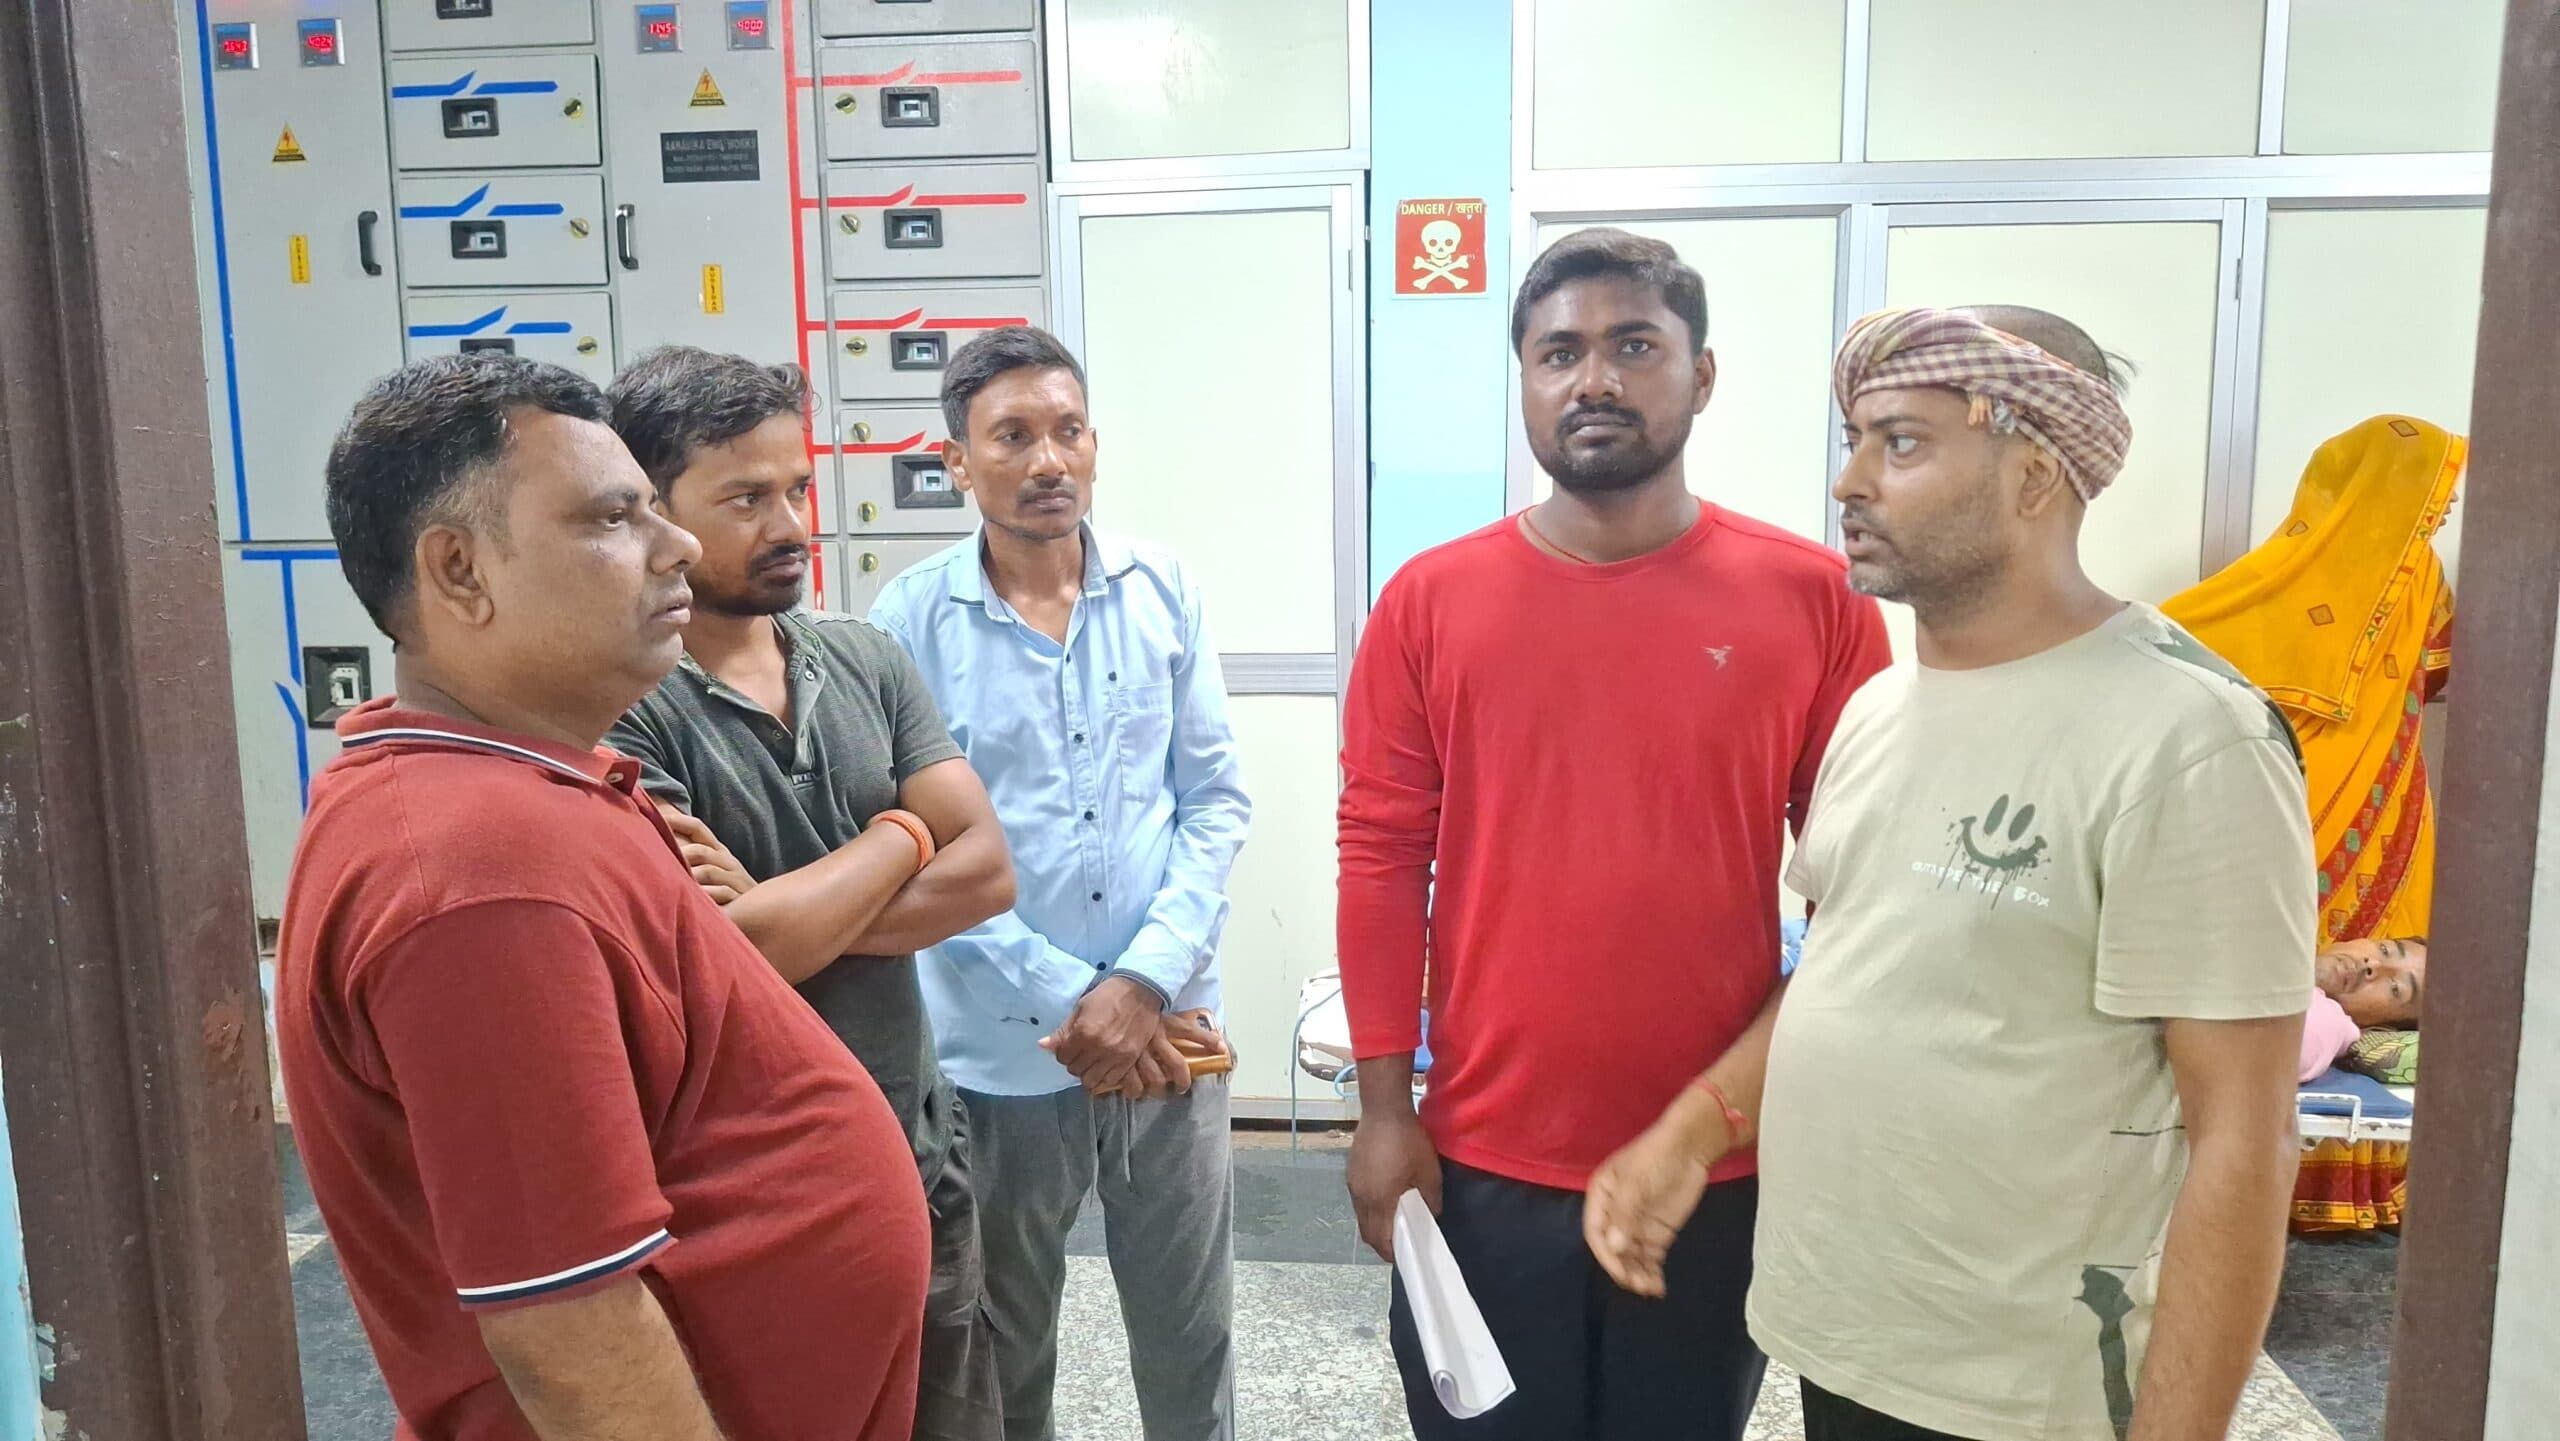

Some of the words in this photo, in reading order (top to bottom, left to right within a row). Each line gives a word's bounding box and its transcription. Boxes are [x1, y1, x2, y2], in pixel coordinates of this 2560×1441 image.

[1401, 203, 1445, 215] DANGER
[1455, 202, 1483, 214] खतरा
[2014, 885, 2050, 907] BOX
